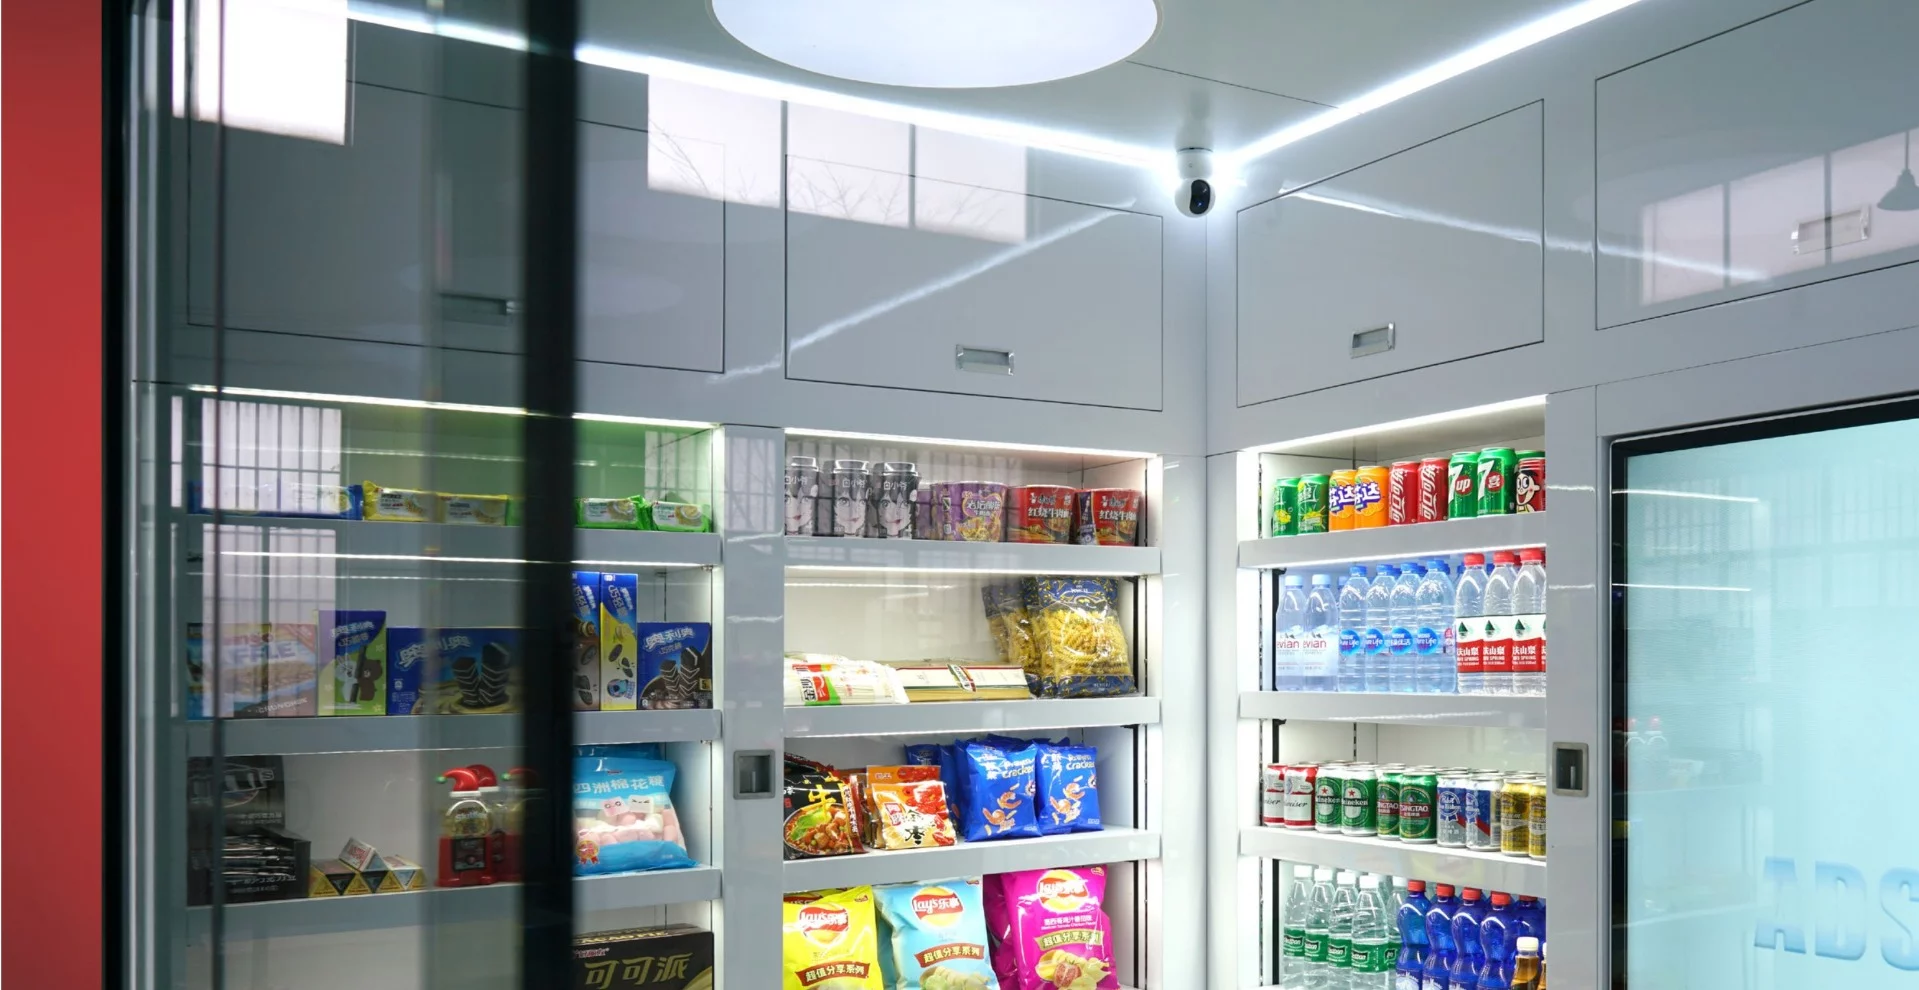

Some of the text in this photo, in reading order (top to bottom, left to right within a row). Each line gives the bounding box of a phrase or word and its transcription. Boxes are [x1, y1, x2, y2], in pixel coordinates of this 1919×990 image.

[913, 898, 938, 914] Lay's
[924, 945, 980, 963] 超值分享系列
[584, 953, 694, 990] 可可派
[805, 964, 865, 982] 超值分享系列
